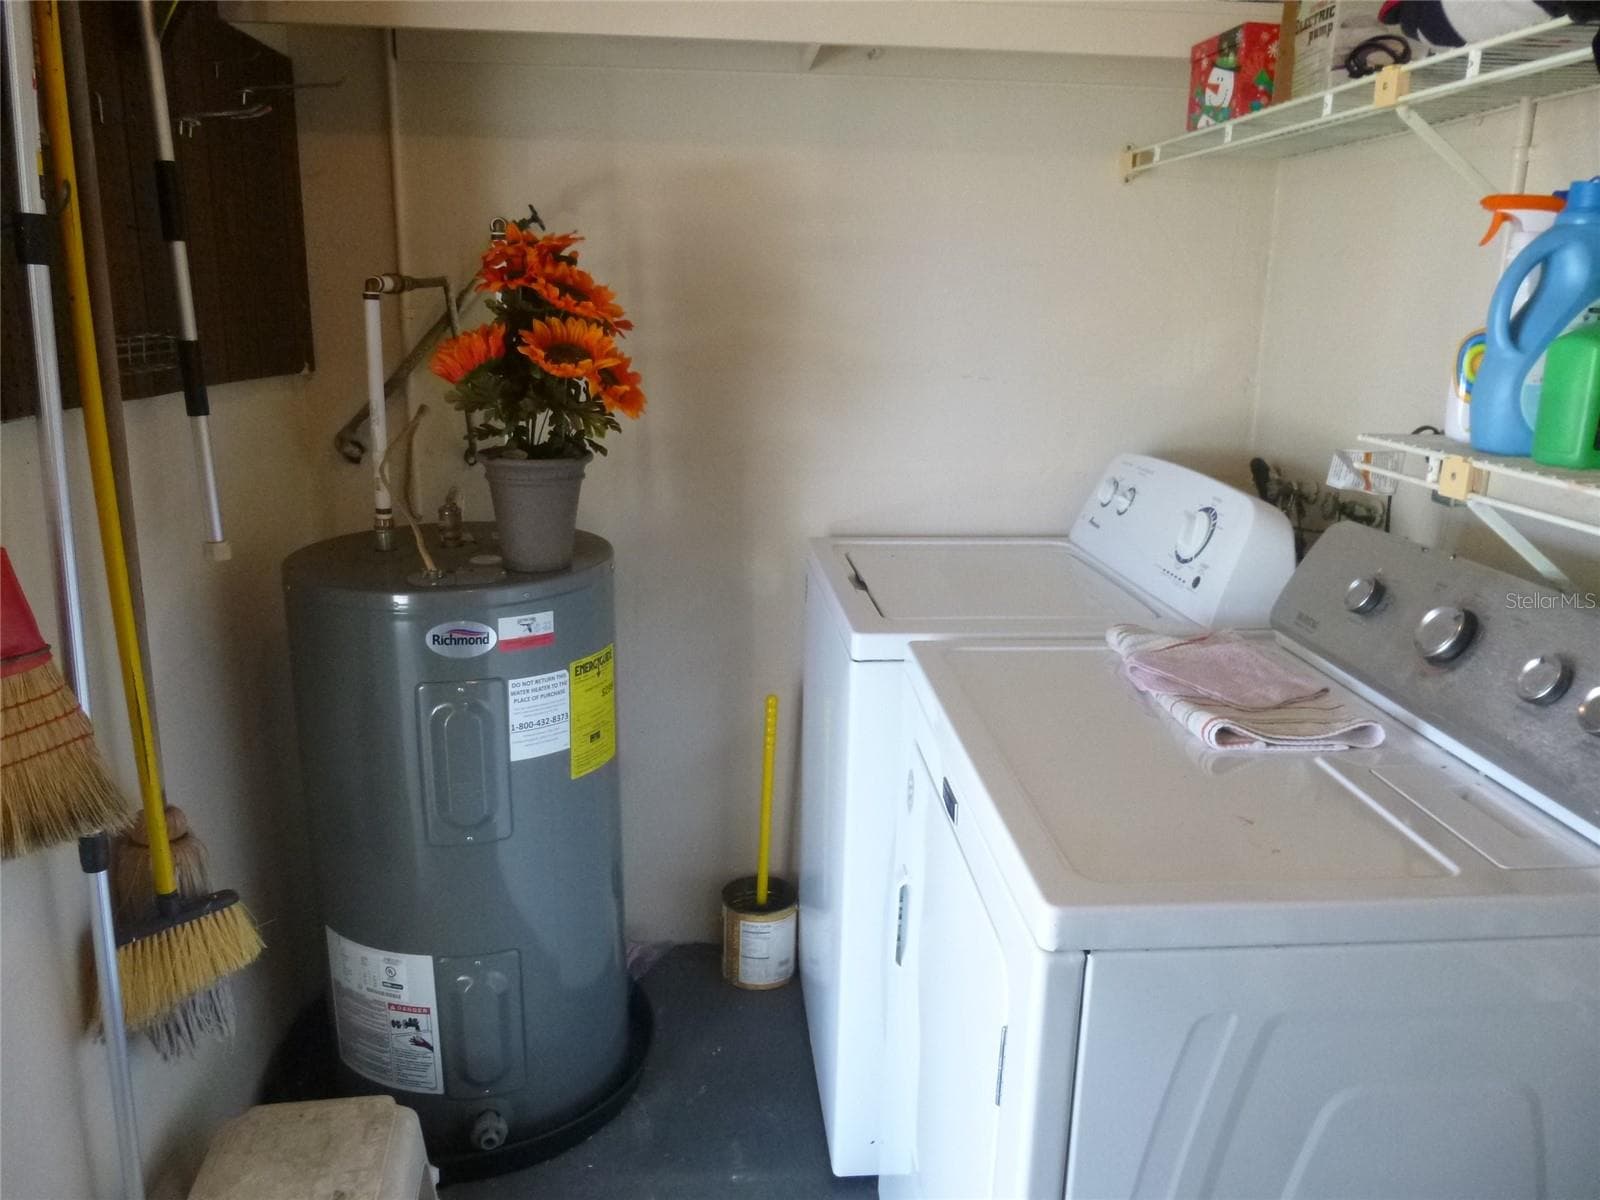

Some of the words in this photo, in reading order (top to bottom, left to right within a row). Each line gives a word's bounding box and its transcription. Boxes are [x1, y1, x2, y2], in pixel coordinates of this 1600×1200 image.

[432, 632, 490, 646] Richmond
[534, 676, 555, 684] RETURN
[510, 688, 529, 698] WATER
[530, 685, 550, 693] HEATER
[513, 696, 530, 705] PLACE
[531, 694, 539, 702] OF
[540, 688, 565, 700] PURCHASE
[511, 712, 569, 731] 1-800-432-8373
[396, 1005, 428, 1013] DANGER
